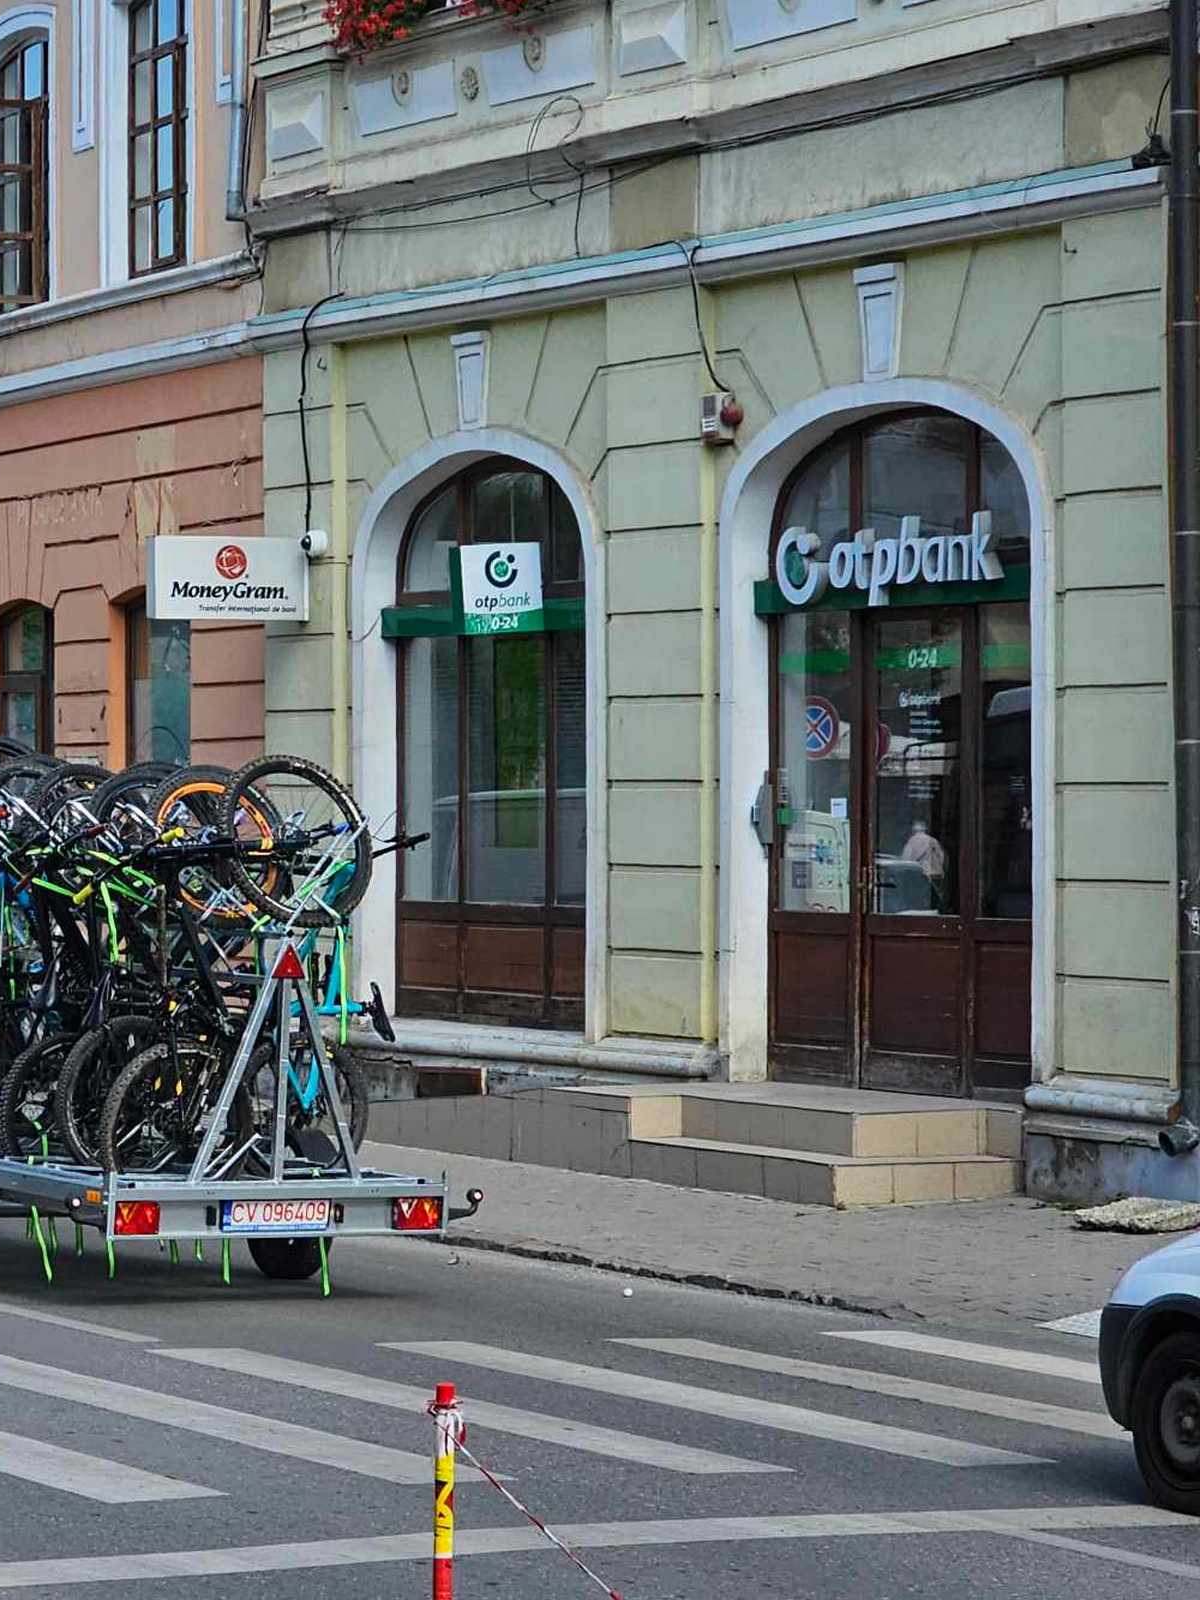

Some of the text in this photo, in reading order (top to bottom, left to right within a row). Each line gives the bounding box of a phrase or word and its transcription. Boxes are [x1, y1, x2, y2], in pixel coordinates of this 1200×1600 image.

[829, 510, 1004, 606] otpbank
[171, 581, 285, 602] MoneyGram
[475, 592, 531, 611] otpbank
[198, 604, 226, 614] Transfer
[272, 605, 280, 613] de
[492, 615, 519, 630] 0-24
[908, 648, 937, 668] 0-24
[232, 1201, 326, 1223] CV 096409
